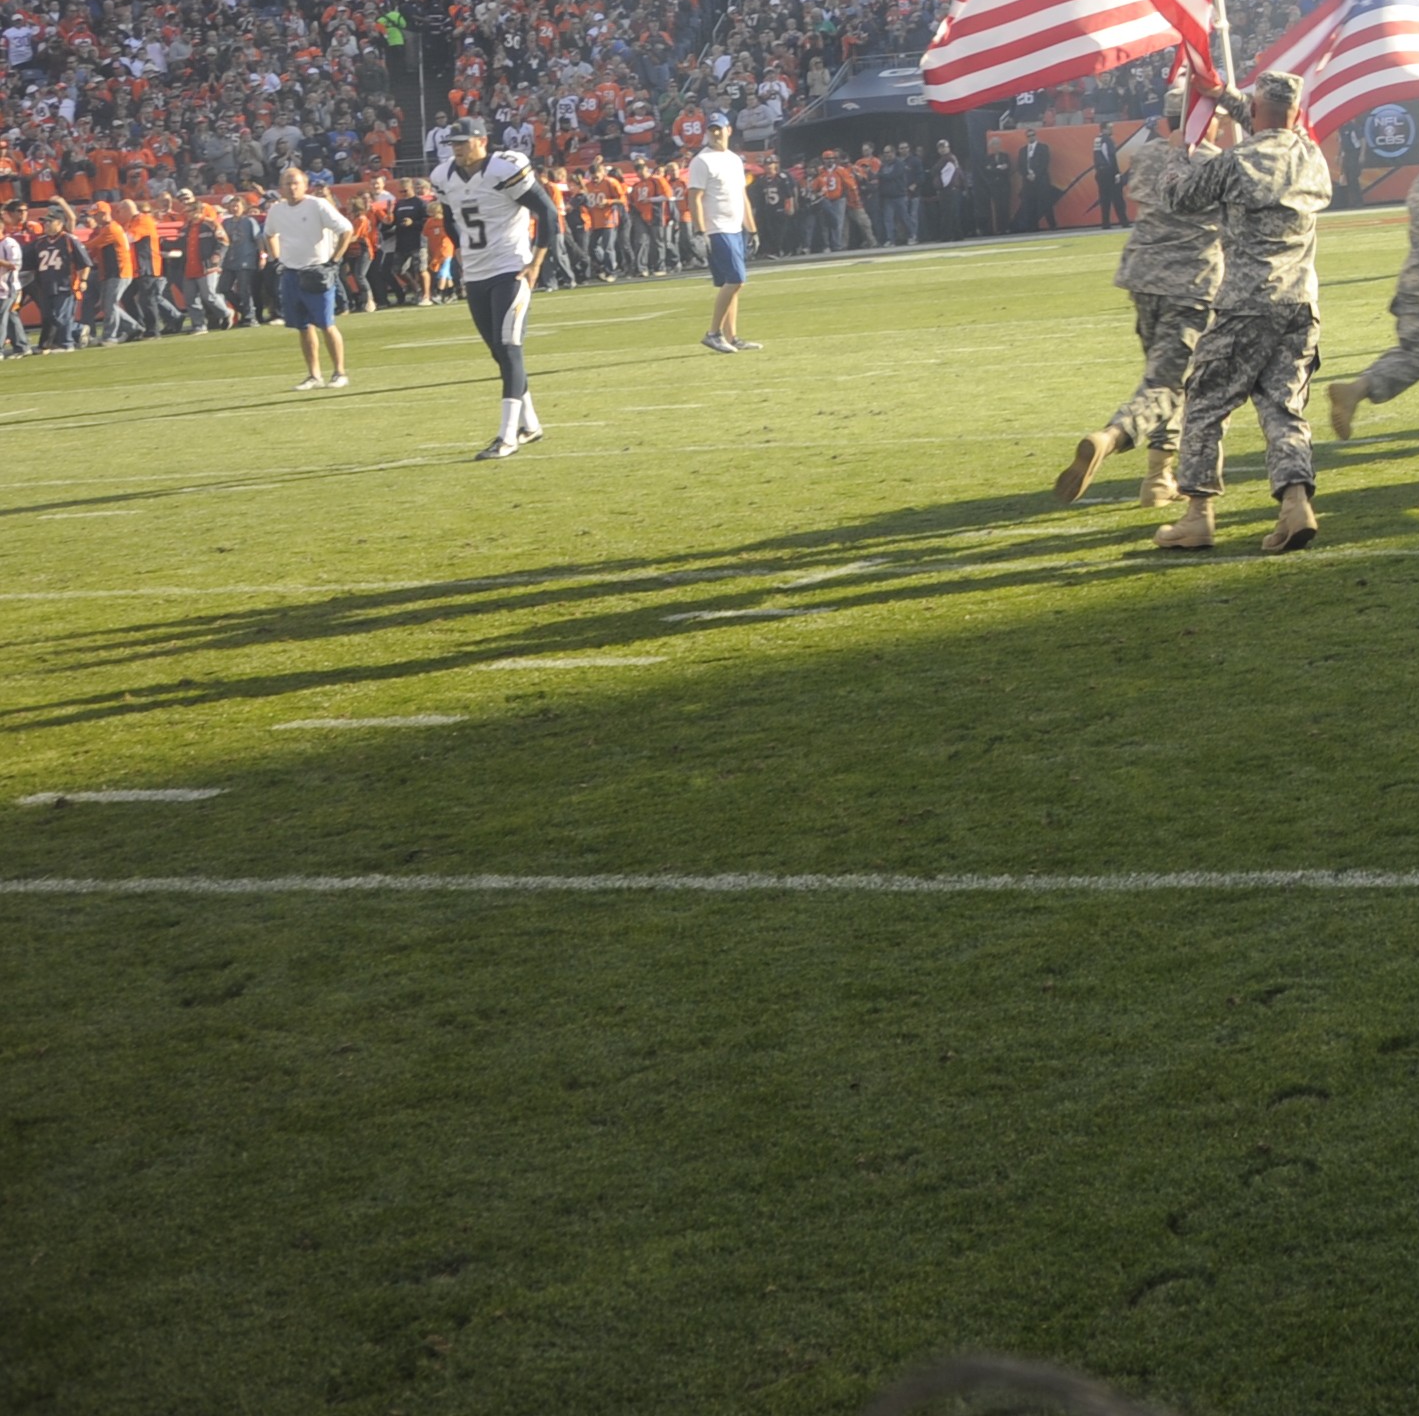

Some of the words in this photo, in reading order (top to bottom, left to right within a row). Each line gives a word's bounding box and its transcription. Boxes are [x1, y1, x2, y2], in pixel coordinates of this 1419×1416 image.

[682, 122, 702, 135] 58
[1373, 116, 1405, 127] NFL
[1375, 134, 1406, 146] CBS
[587, 192, 606, 208] 80
[461, 206, 488, 250] 5
[38, 250, 63, 271] 24
